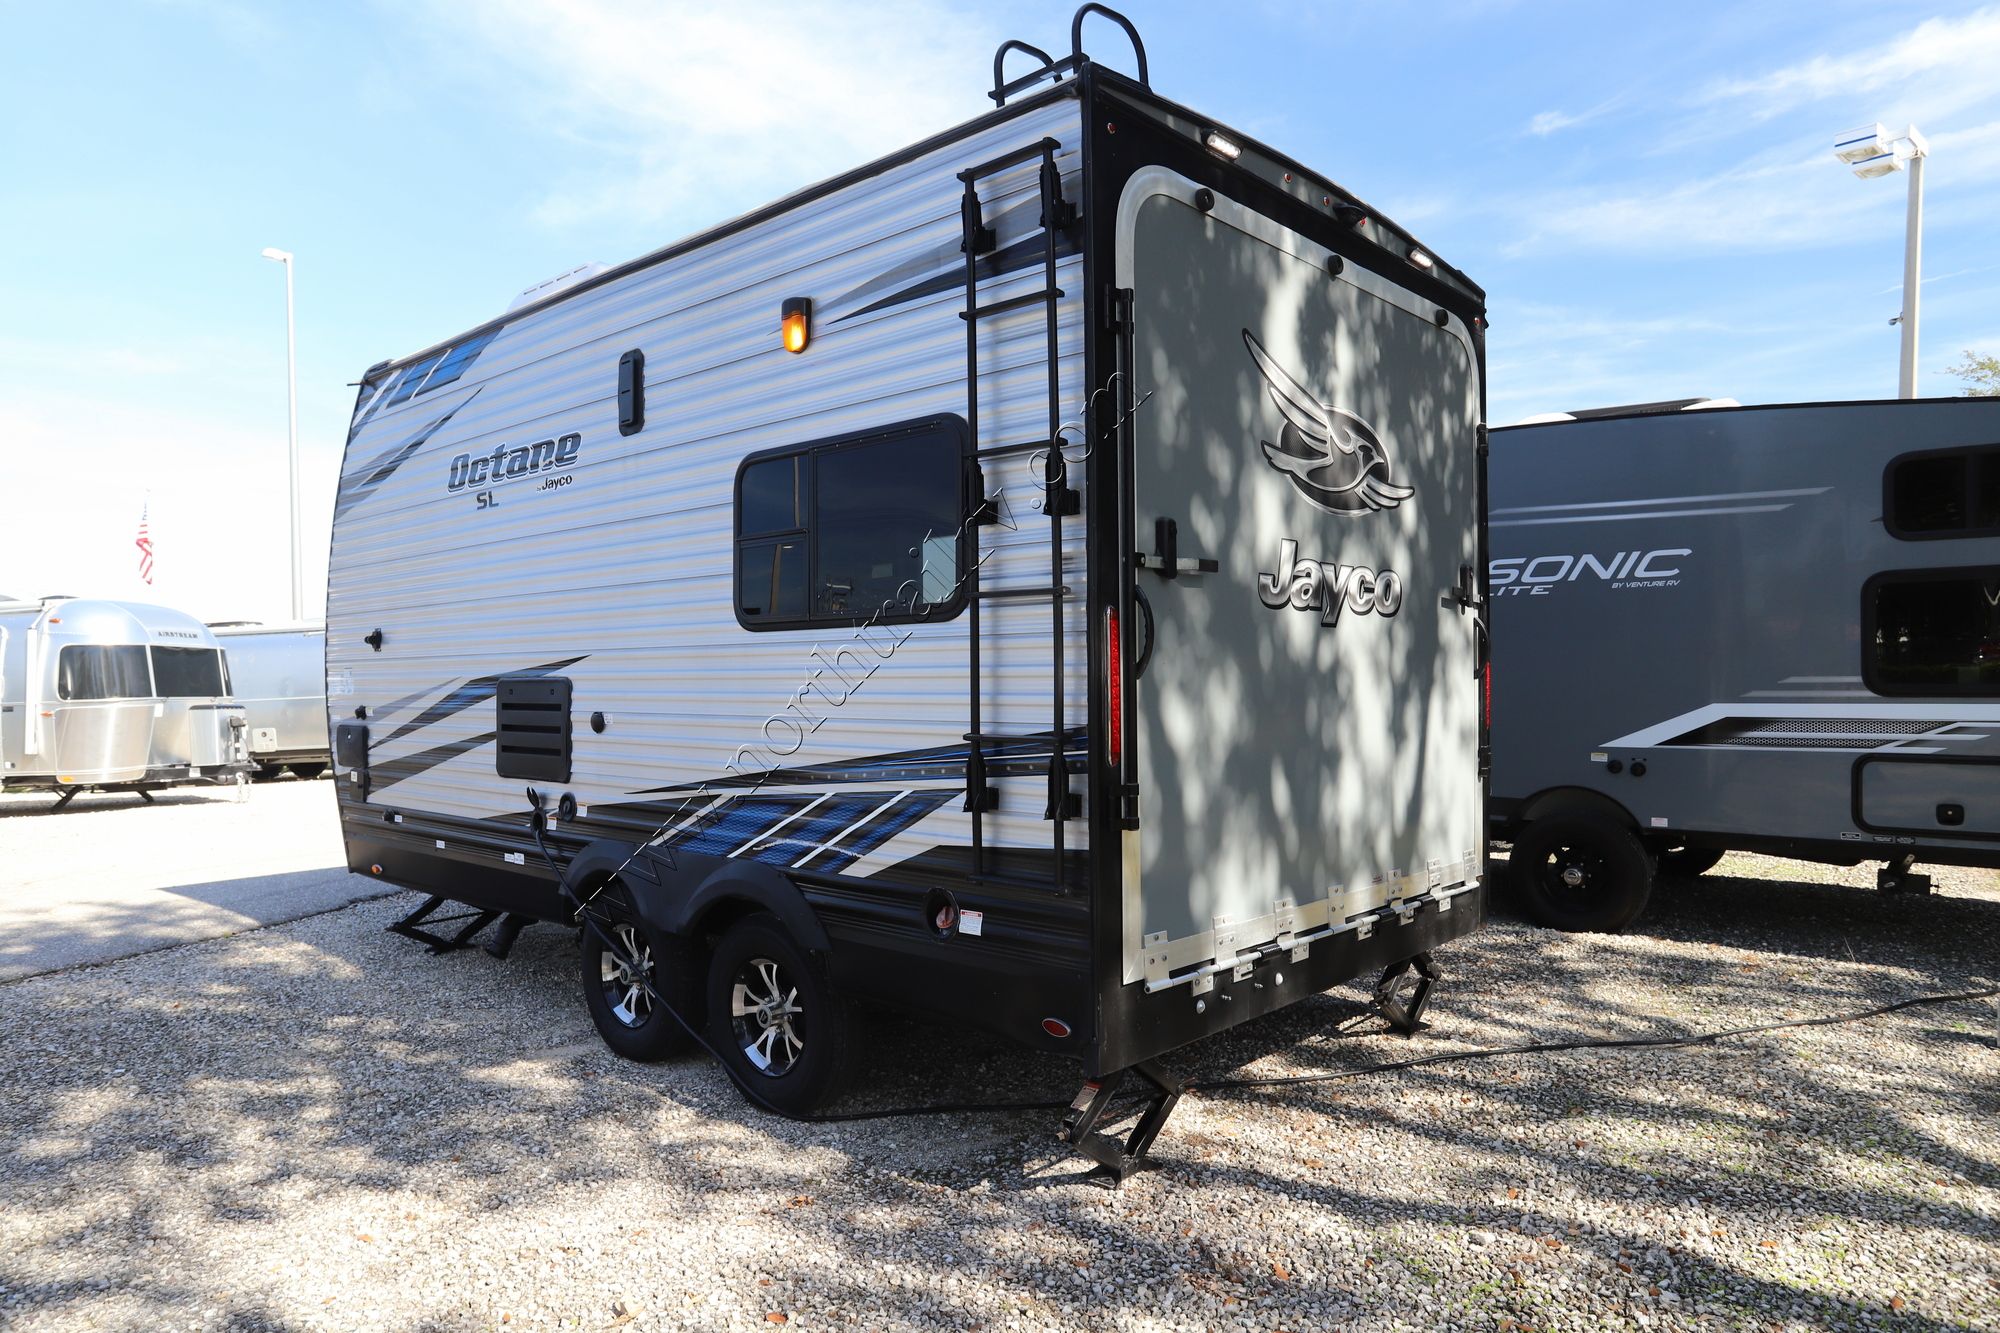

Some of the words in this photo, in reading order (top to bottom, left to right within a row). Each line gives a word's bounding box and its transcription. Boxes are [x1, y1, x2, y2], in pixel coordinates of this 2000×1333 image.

[448, 431, 582, 493] Octane
[541, 474, 573, 491] Jayco
[476, 491, 500, 510] SL
[1489, 548, 1693, 585] SONIC
[1258, 537, 1403, 628] Jayco
[1489, 585, 1553, 597] ITE
[1626, 580, 1666, 588] VENTURE
[1666, 579, 1681, 587] RV
[158, 631, 198, 639] AIRSTREAM
